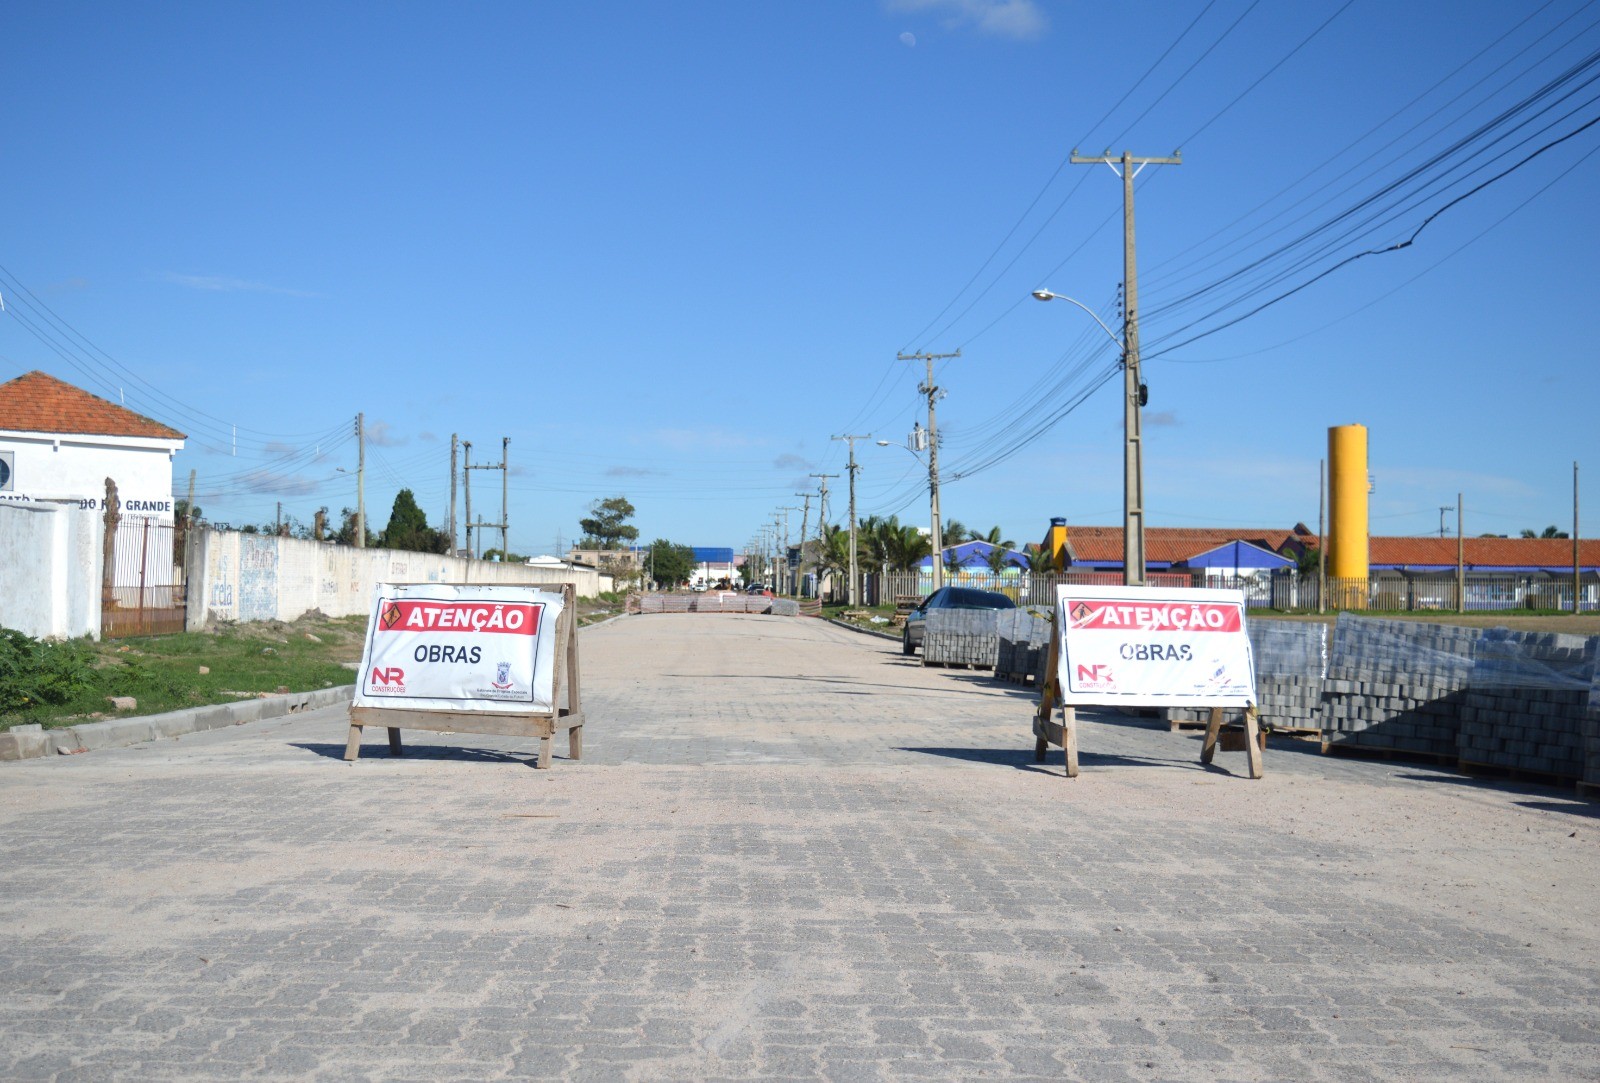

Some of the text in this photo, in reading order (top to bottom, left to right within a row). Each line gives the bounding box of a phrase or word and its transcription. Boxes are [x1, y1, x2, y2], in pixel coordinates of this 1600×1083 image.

[126, 500, 171, 512] GRANDE
[406, 605, 525, 632] ATENÇÃO
[1102, 604, 1225, 631] ATENÇÃO
[414, 644, 482, 664] OBRAS
[1120, 643, 1193, 661] OBRAS
[371, 667, 405, 685] NR
